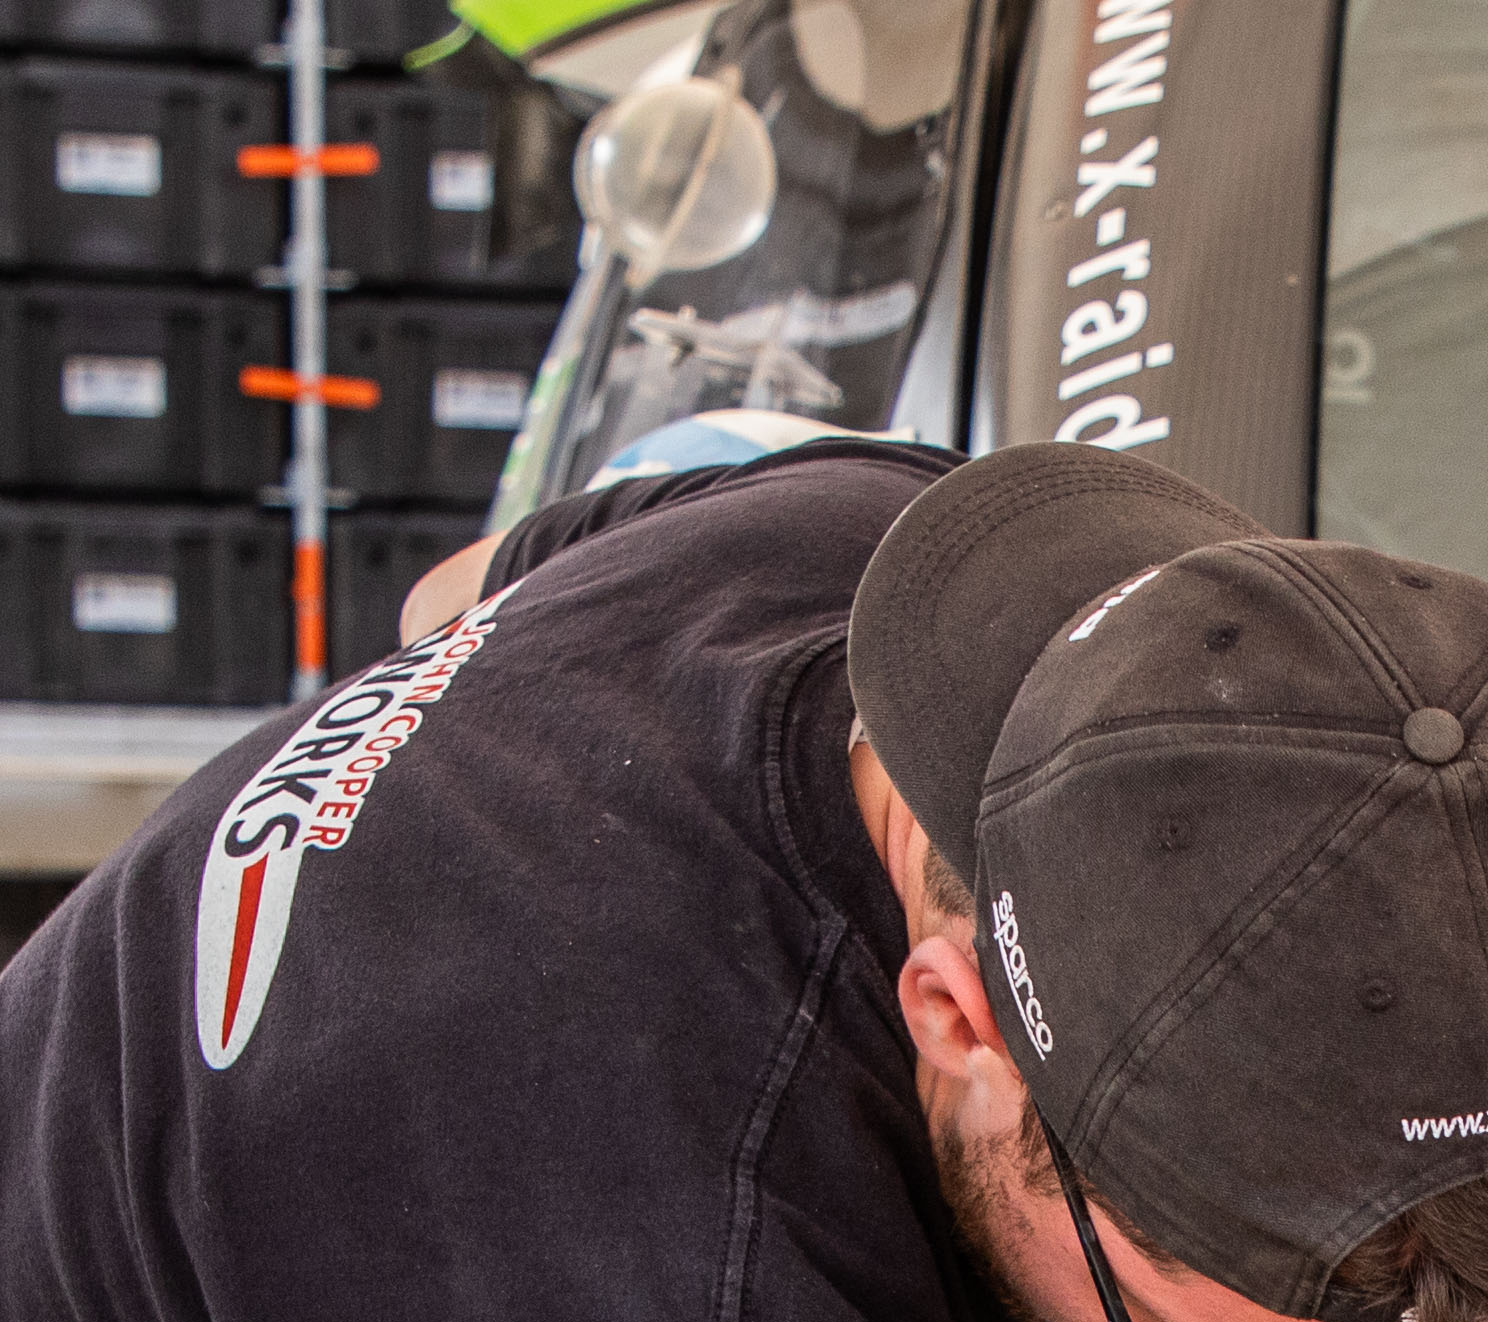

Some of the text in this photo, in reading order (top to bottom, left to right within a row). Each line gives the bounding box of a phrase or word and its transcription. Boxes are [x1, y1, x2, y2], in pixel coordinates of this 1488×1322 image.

[302, 624, 491, 845] JOHN COOPER
[993, 890, 1054, 1055] sparco
